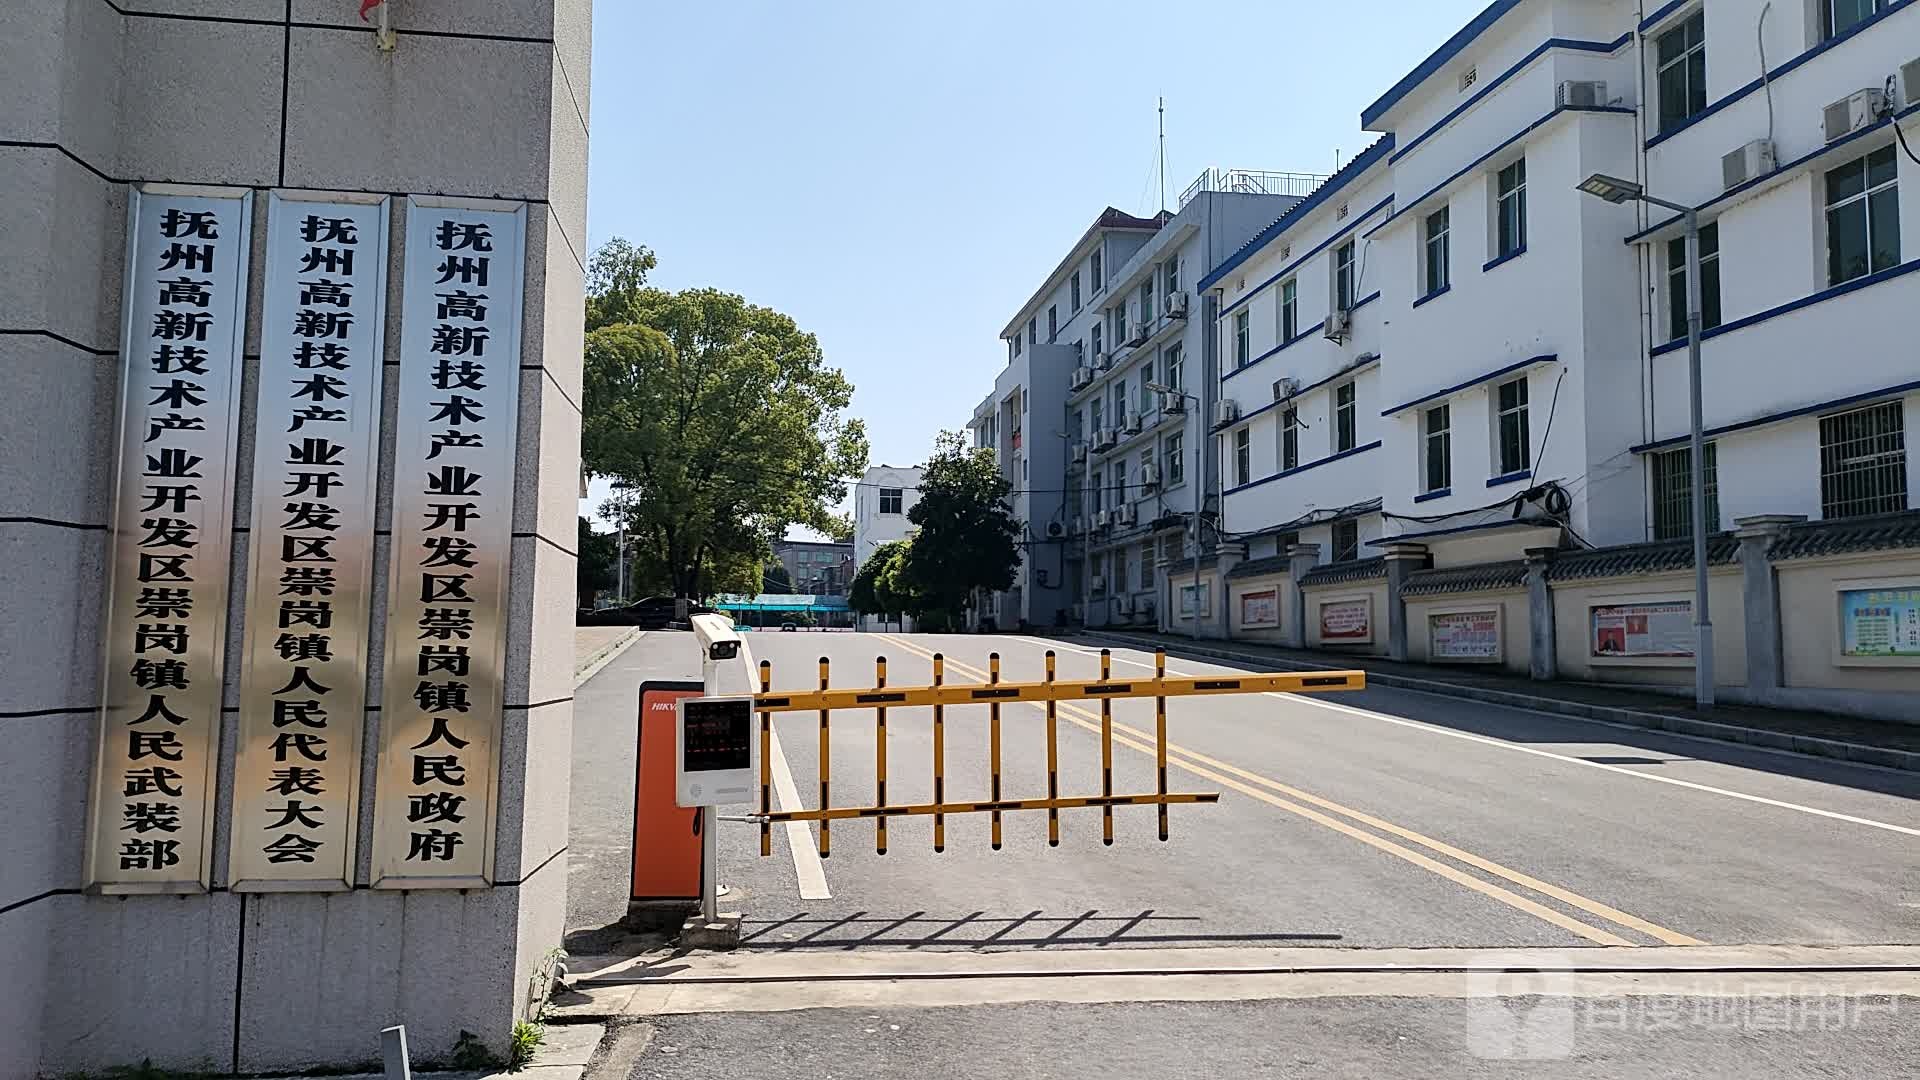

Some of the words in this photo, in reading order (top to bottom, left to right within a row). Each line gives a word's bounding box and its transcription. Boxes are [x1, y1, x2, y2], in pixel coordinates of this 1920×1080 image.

[119, 208, 218, 872] 抚州高新技术产业开发区崇岗镇人民武装部
[262, 214, 358, 864] 抚州高新技术产业开发区崇岗镇人民代表大会
[406, 220, 493, 862] 抚州高新技术产业开发区崇岗镇人民政府
